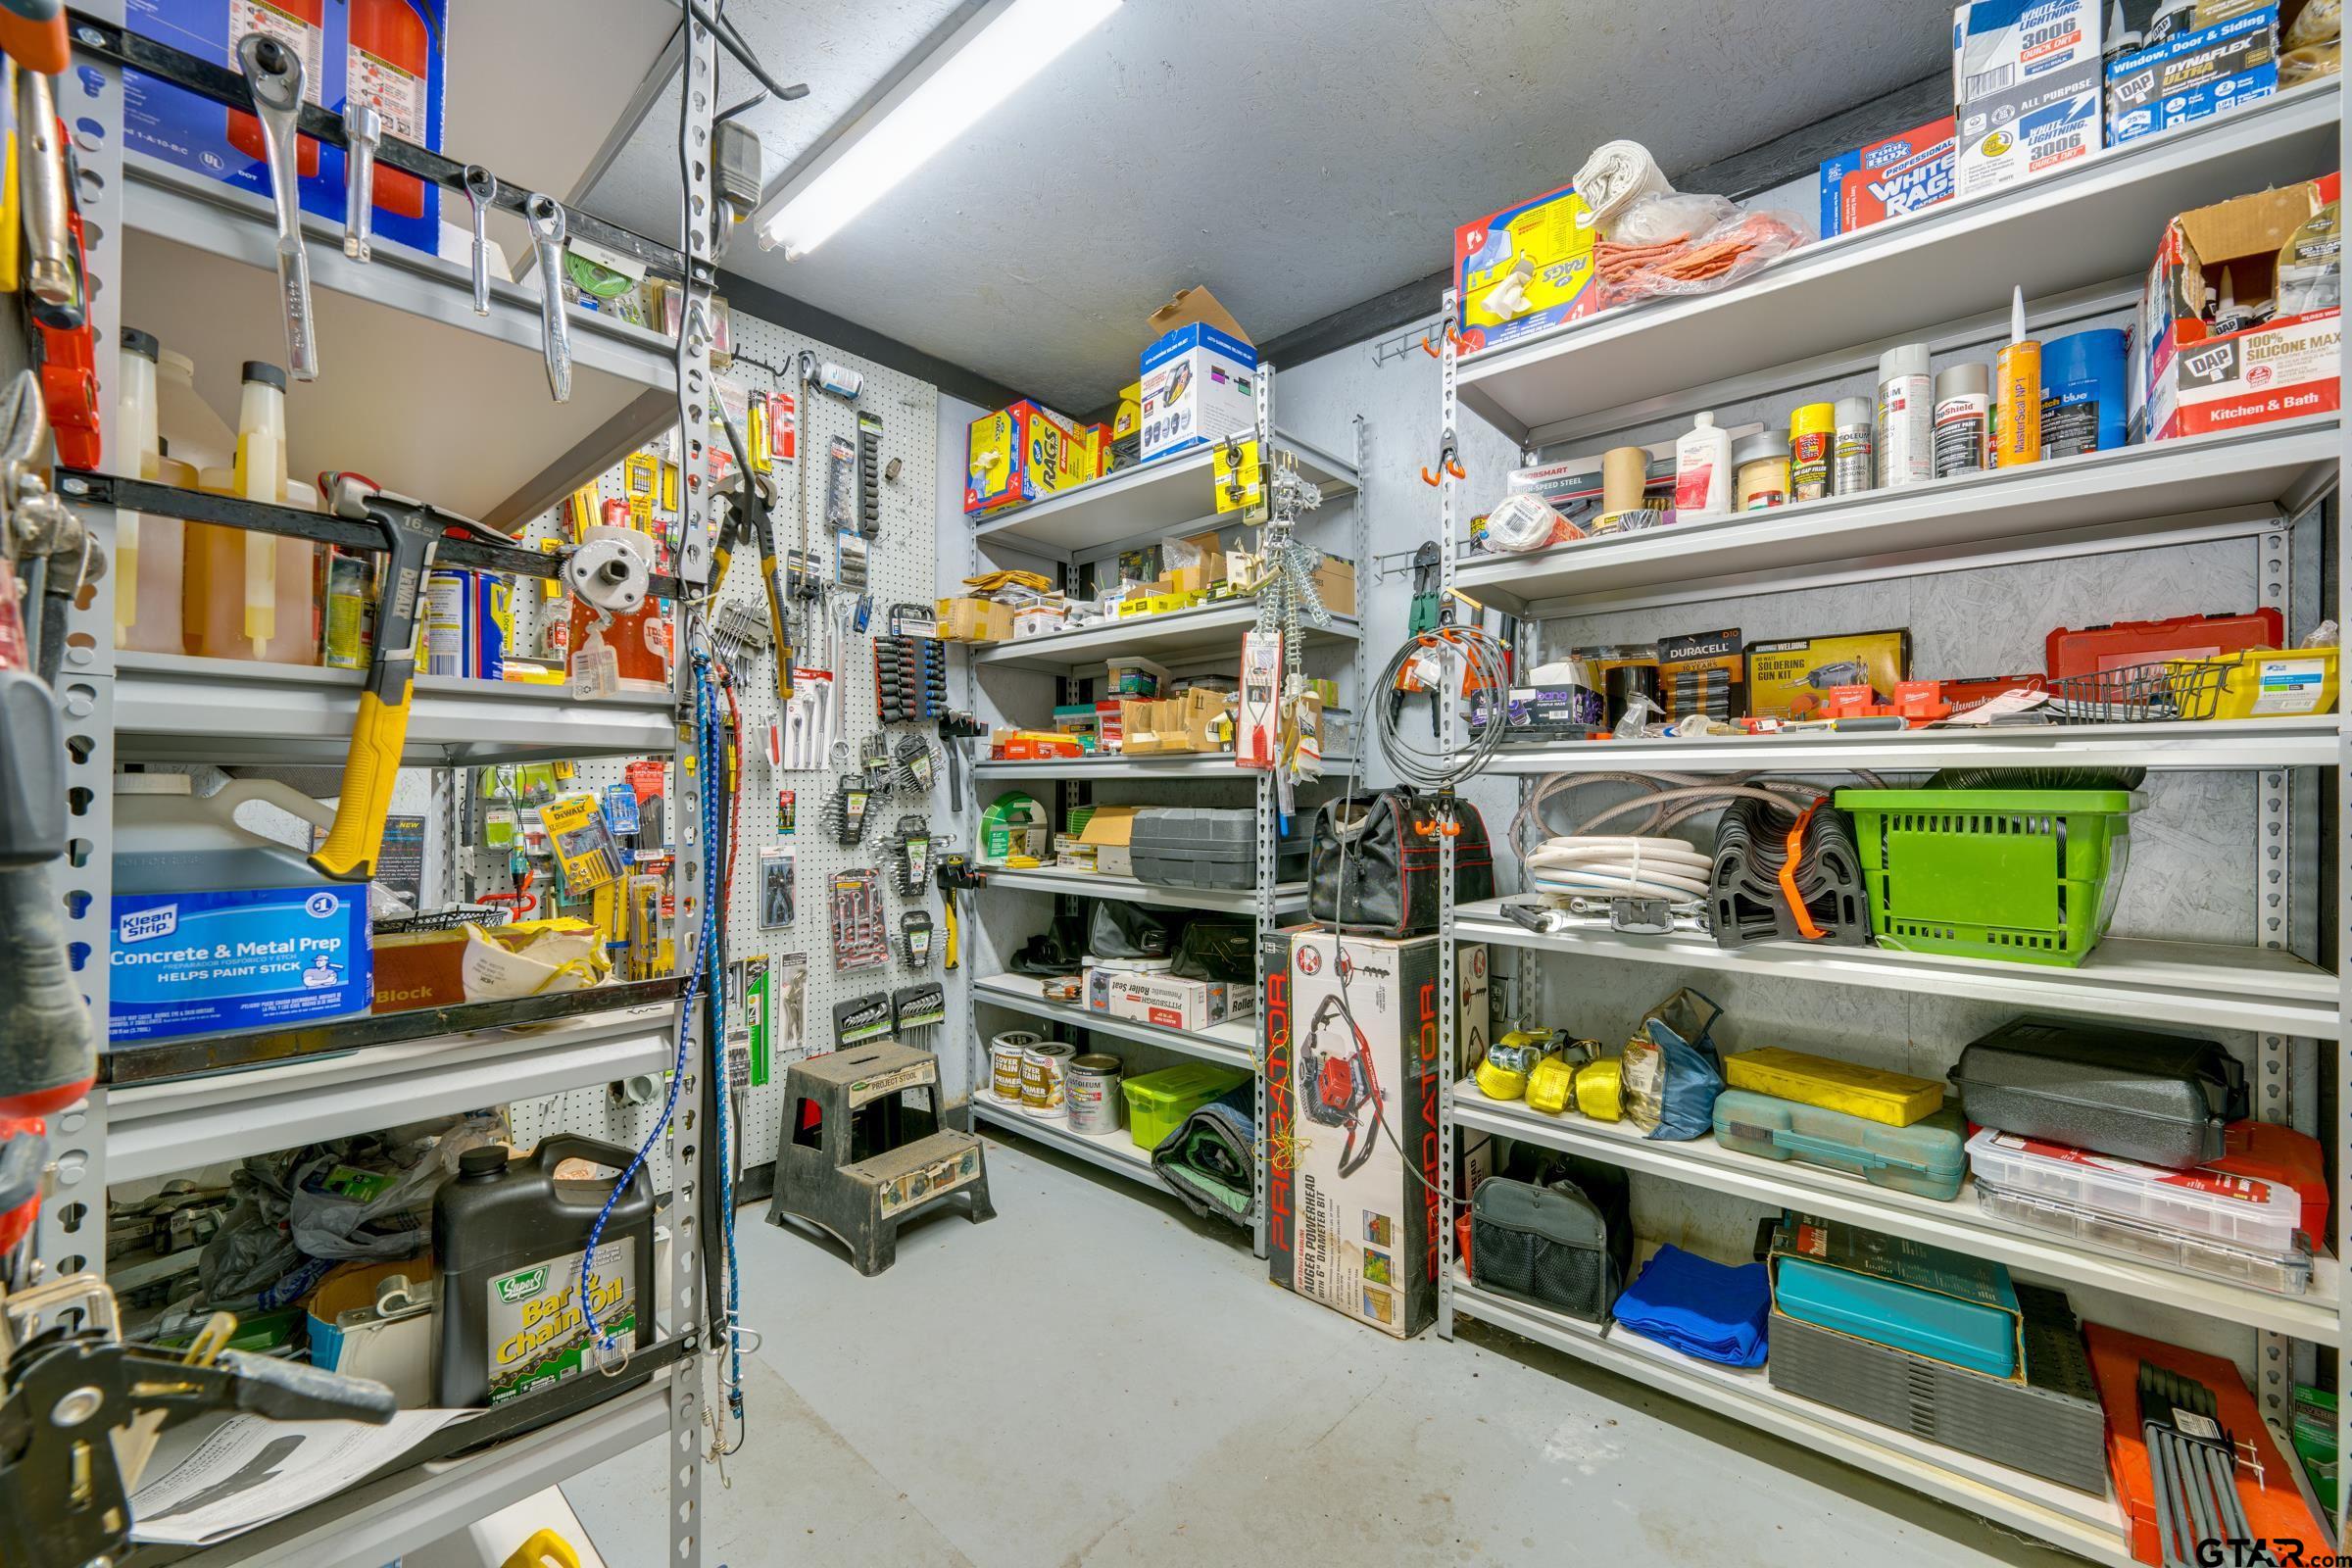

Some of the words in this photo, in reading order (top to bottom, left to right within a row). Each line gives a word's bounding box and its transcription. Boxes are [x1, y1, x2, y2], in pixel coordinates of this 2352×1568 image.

[2021, 1, 2060, 21] WHITE
[2022, 18, 2077, 50] 3006
[2023, 41, 2051, 61] QUICK
[2054, 35, 2074, 49] DRY
[2114, 49, 2169, 74] Window,
[2172, 36, 2204, 55] Door
[2206, 28, 2219, 41] &
[2221, 15, 2266, 35] Siding
[2165, 37, 2254, 76] DYNAFLEX
[2163, 61, 2215, 86] ULTRA
[2021, 98, 2039, 111] ALL
[2043, 77, 2093, 103] PURPOSE
[2121, 74, 2153, 100] DAP
[2126, 113, 2147, 124] 25%
[2029, 119, 2063, 138] WHITE
[1867, 141, 1907, 159] TOOL
[2031, 133, 2082, 162] 3006
[203, 153, 221, 170] UL
[1867, 148, 1911, 169] BOX
[1886, 140, 1954, 177] PROFESSIONAL
[2032, 157, 2059, 172] QUICK
[237, 170, 258, 182] DOT
[1867, 152, 1955, 202] WHITE
[1543, 256, 1589, 283] RAGS
[2217, 320, 2237, 334] DAP
[2246, 334, 2283, 350] 100%
[2246, 338, 2306, 362] SILICONE
[2310, 331, 2341, 347] MAX
[2192, 348, 2230, 373] DAP
[2063, 392, 2088, 403] blue
[2210, 402, 2265, 421] Kitchen
[2267, 397, 2281, 411] &
[2283, 392, 2320, 409] Bath
[2014, 398, 2026, 454] MasterSeal
[1044, 426, 1057, 490] RAGS
[1560, 477, 1583, 488] STEEL
[403, 515, 422, 529] 16
[1722, 630, 1739, 639] D10
[1670, 643, 1729, 659] DURACELL
[1778, 641, 1808, 653] WELDING
[1691, 662, 1718, 672] YEARS
[1757, 659, 1805, 671] SOLDERING
[1757, 671, 1776, 681] GUN
[1777, 670, 1791, 680] KIT
[1536, 690, 1568, 702] bang
[123, 911, 172, 929] Klean
[110, 947, 209, 966] Concrete
[214, 944, 231, 959] &
[237, 939, 294, 957] Metal
[300, 937, 341, 953] Prep
[158, 970, 209, 983] HELPS
[213, 964, 255, 978] PAINT
[260, 961, 301, 974] STICK
[376, 987, 432, 1004] Block
[1111, 981, 1127, 993] Seat
[1127, 983, 1150, 996] Roller
[1142, 997, 1182, 1010] PITTSBURGH
[1232, 998, 1254, 1012] Roller
[995, 1055, 1018, 1066] COVER
[995, 1062, 1018, 1072] STAIN
[871, 1076, 898, 1091] PROJECT
[899, 1072, 916, 1084] STOOL
[995, 1074, 1021, 1085] PRIMER
[1420, 983, 1441, 1283] PREDATOR
[1316, 1191, 1325, 1209] BIT
[1304, 1174, 1315, 1252] POWERHEAD
[1316, 1210, 1326, 1263] DIAMETER
[1304, 1253, 1315, 1295] AUGER
[1316, 1264, 1325, 1278] 6"
[520, 1286, 573, 1330] Bar
[496, 1307, 582, 1365] Chain
[588, 1277, 623, 1314] Oil
